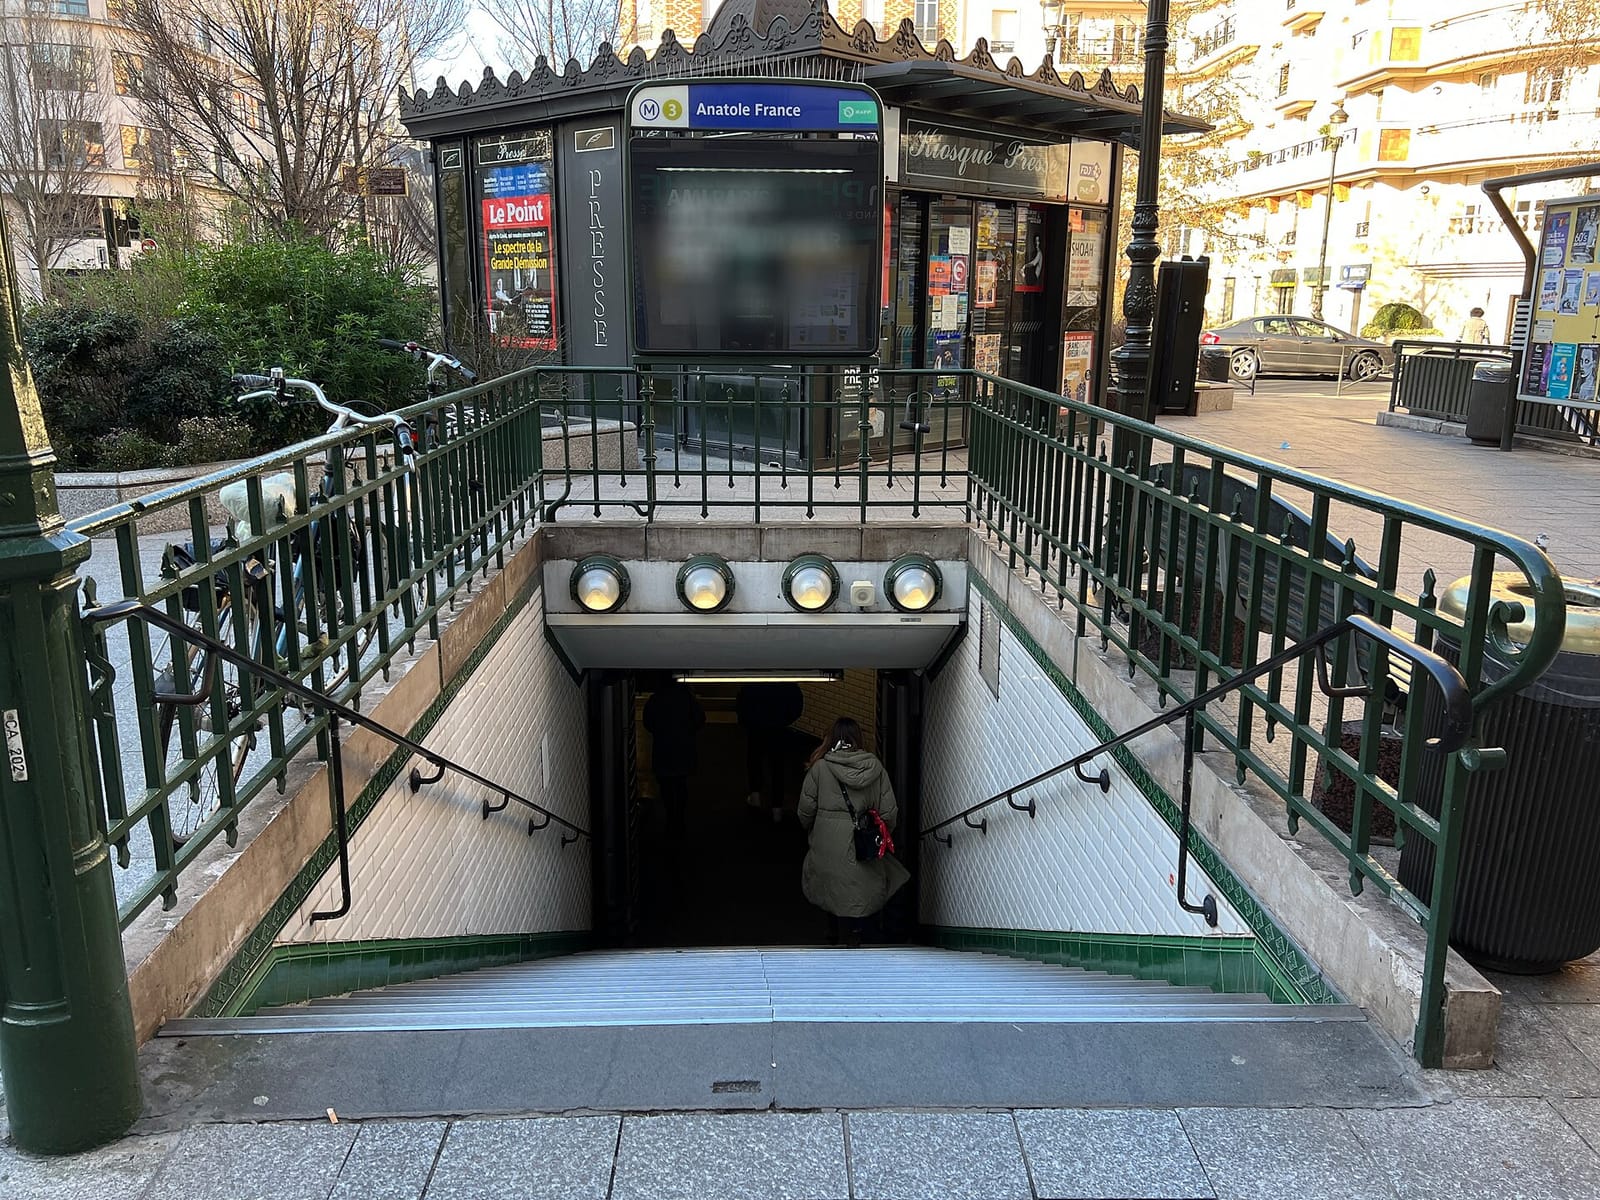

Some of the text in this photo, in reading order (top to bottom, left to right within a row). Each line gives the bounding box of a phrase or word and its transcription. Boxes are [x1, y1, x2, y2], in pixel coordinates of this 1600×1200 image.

[668, 104, 677, 116] 3
[696, 103, 801, 117] Anatole France
[910, 128, 1059, 175] Kiosque Presse
[489, 200, 543, 224] Le Point
[494, 239, 542, 256] Le spectre de la
[1071, 242, 1094, 257] SHOAH
[491, 256, 547, 270] Grande Démission
[589, 169, 608, 347] PRESSE
[5, 720, 25, 773] CA 202
